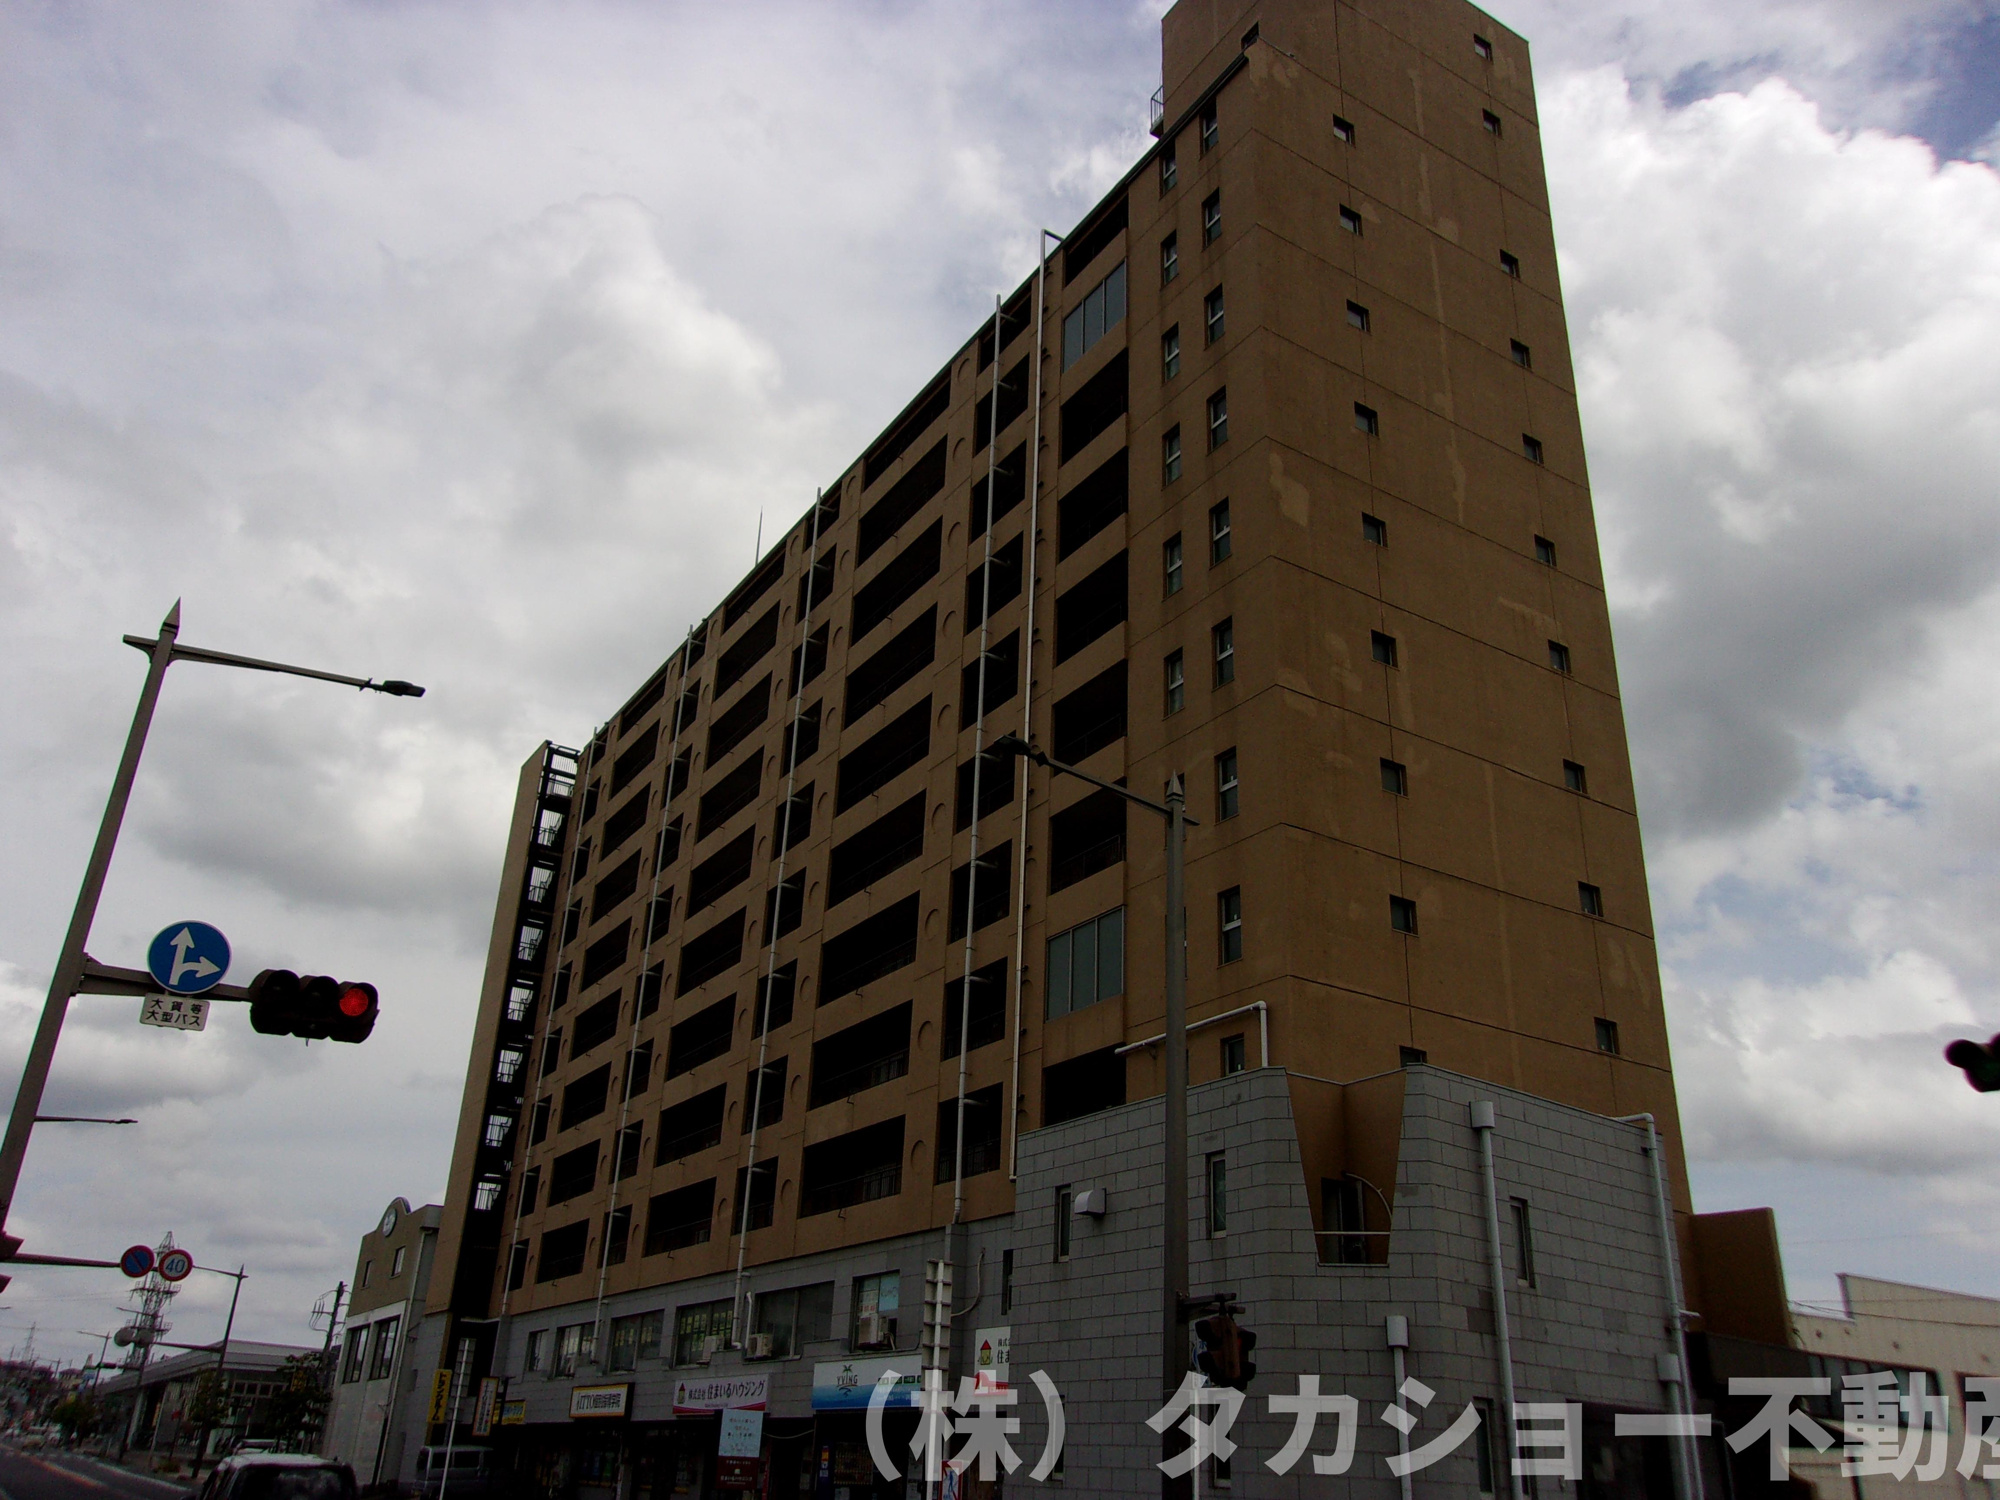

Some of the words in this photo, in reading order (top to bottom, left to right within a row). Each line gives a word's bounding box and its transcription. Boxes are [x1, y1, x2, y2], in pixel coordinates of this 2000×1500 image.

[146, 1010, 200, 1026] 大型バス
[165, 1258, 186, 1274] 40
[707, 1380, 765, 1399] 住まいるハウジング
